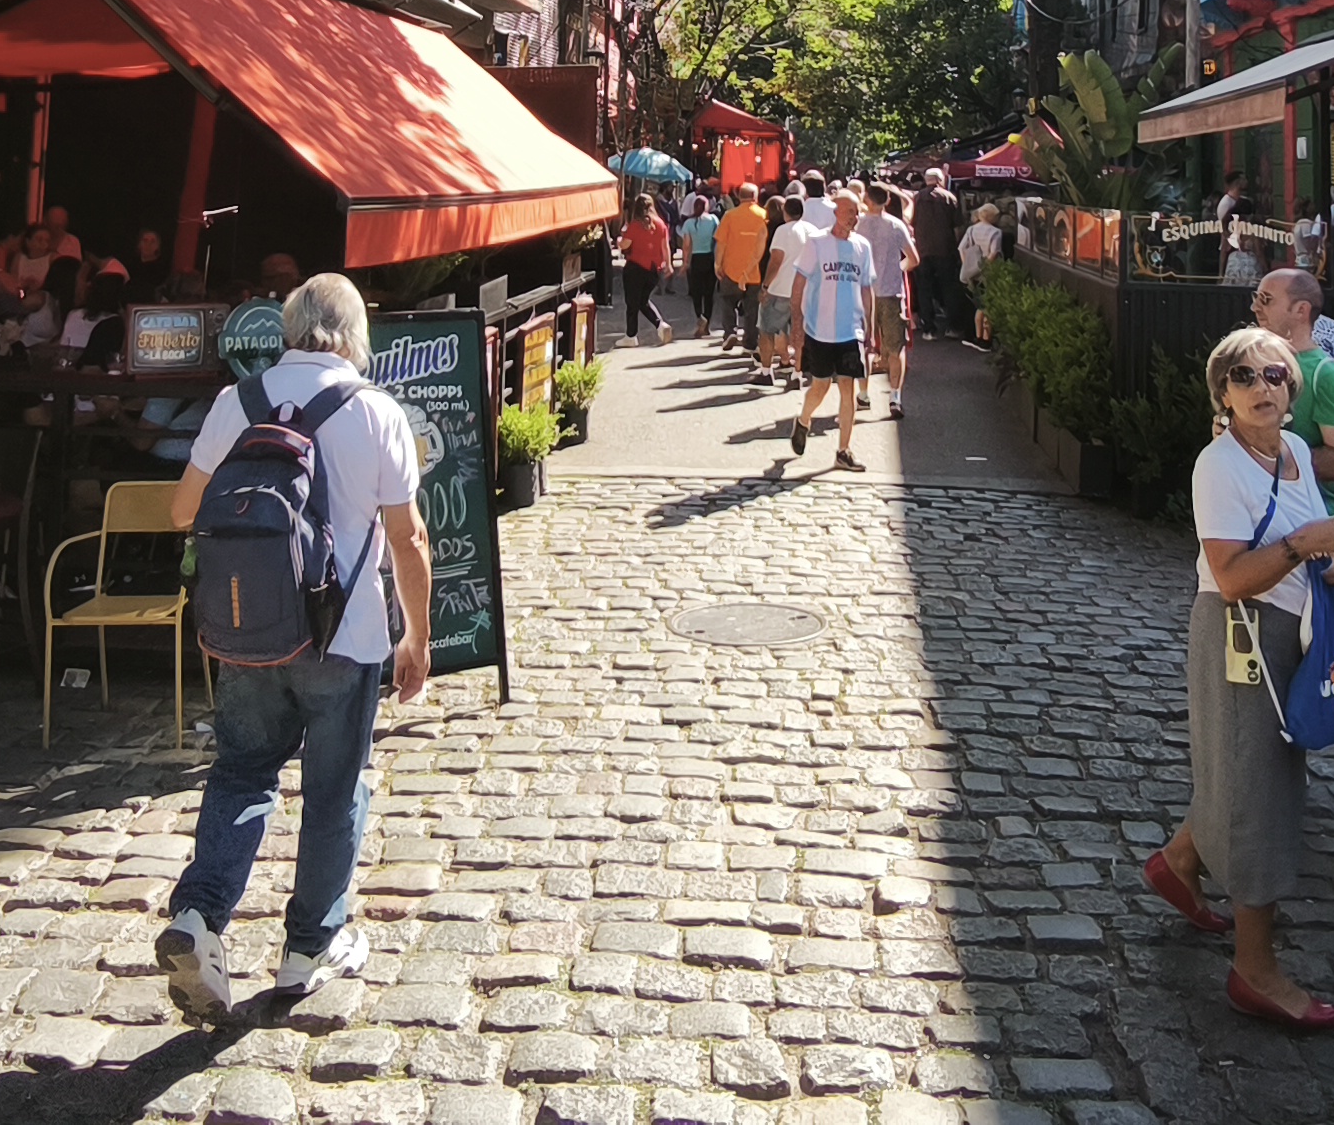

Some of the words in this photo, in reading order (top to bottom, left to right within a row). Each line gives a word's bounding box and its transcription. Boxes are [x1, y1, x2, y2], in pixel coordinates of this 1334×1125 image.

[1161, 220, 1224, 243] ESQUINA
[394, 385, 406, 399] 2
[407, 384, 463, 399] CHOPPS
